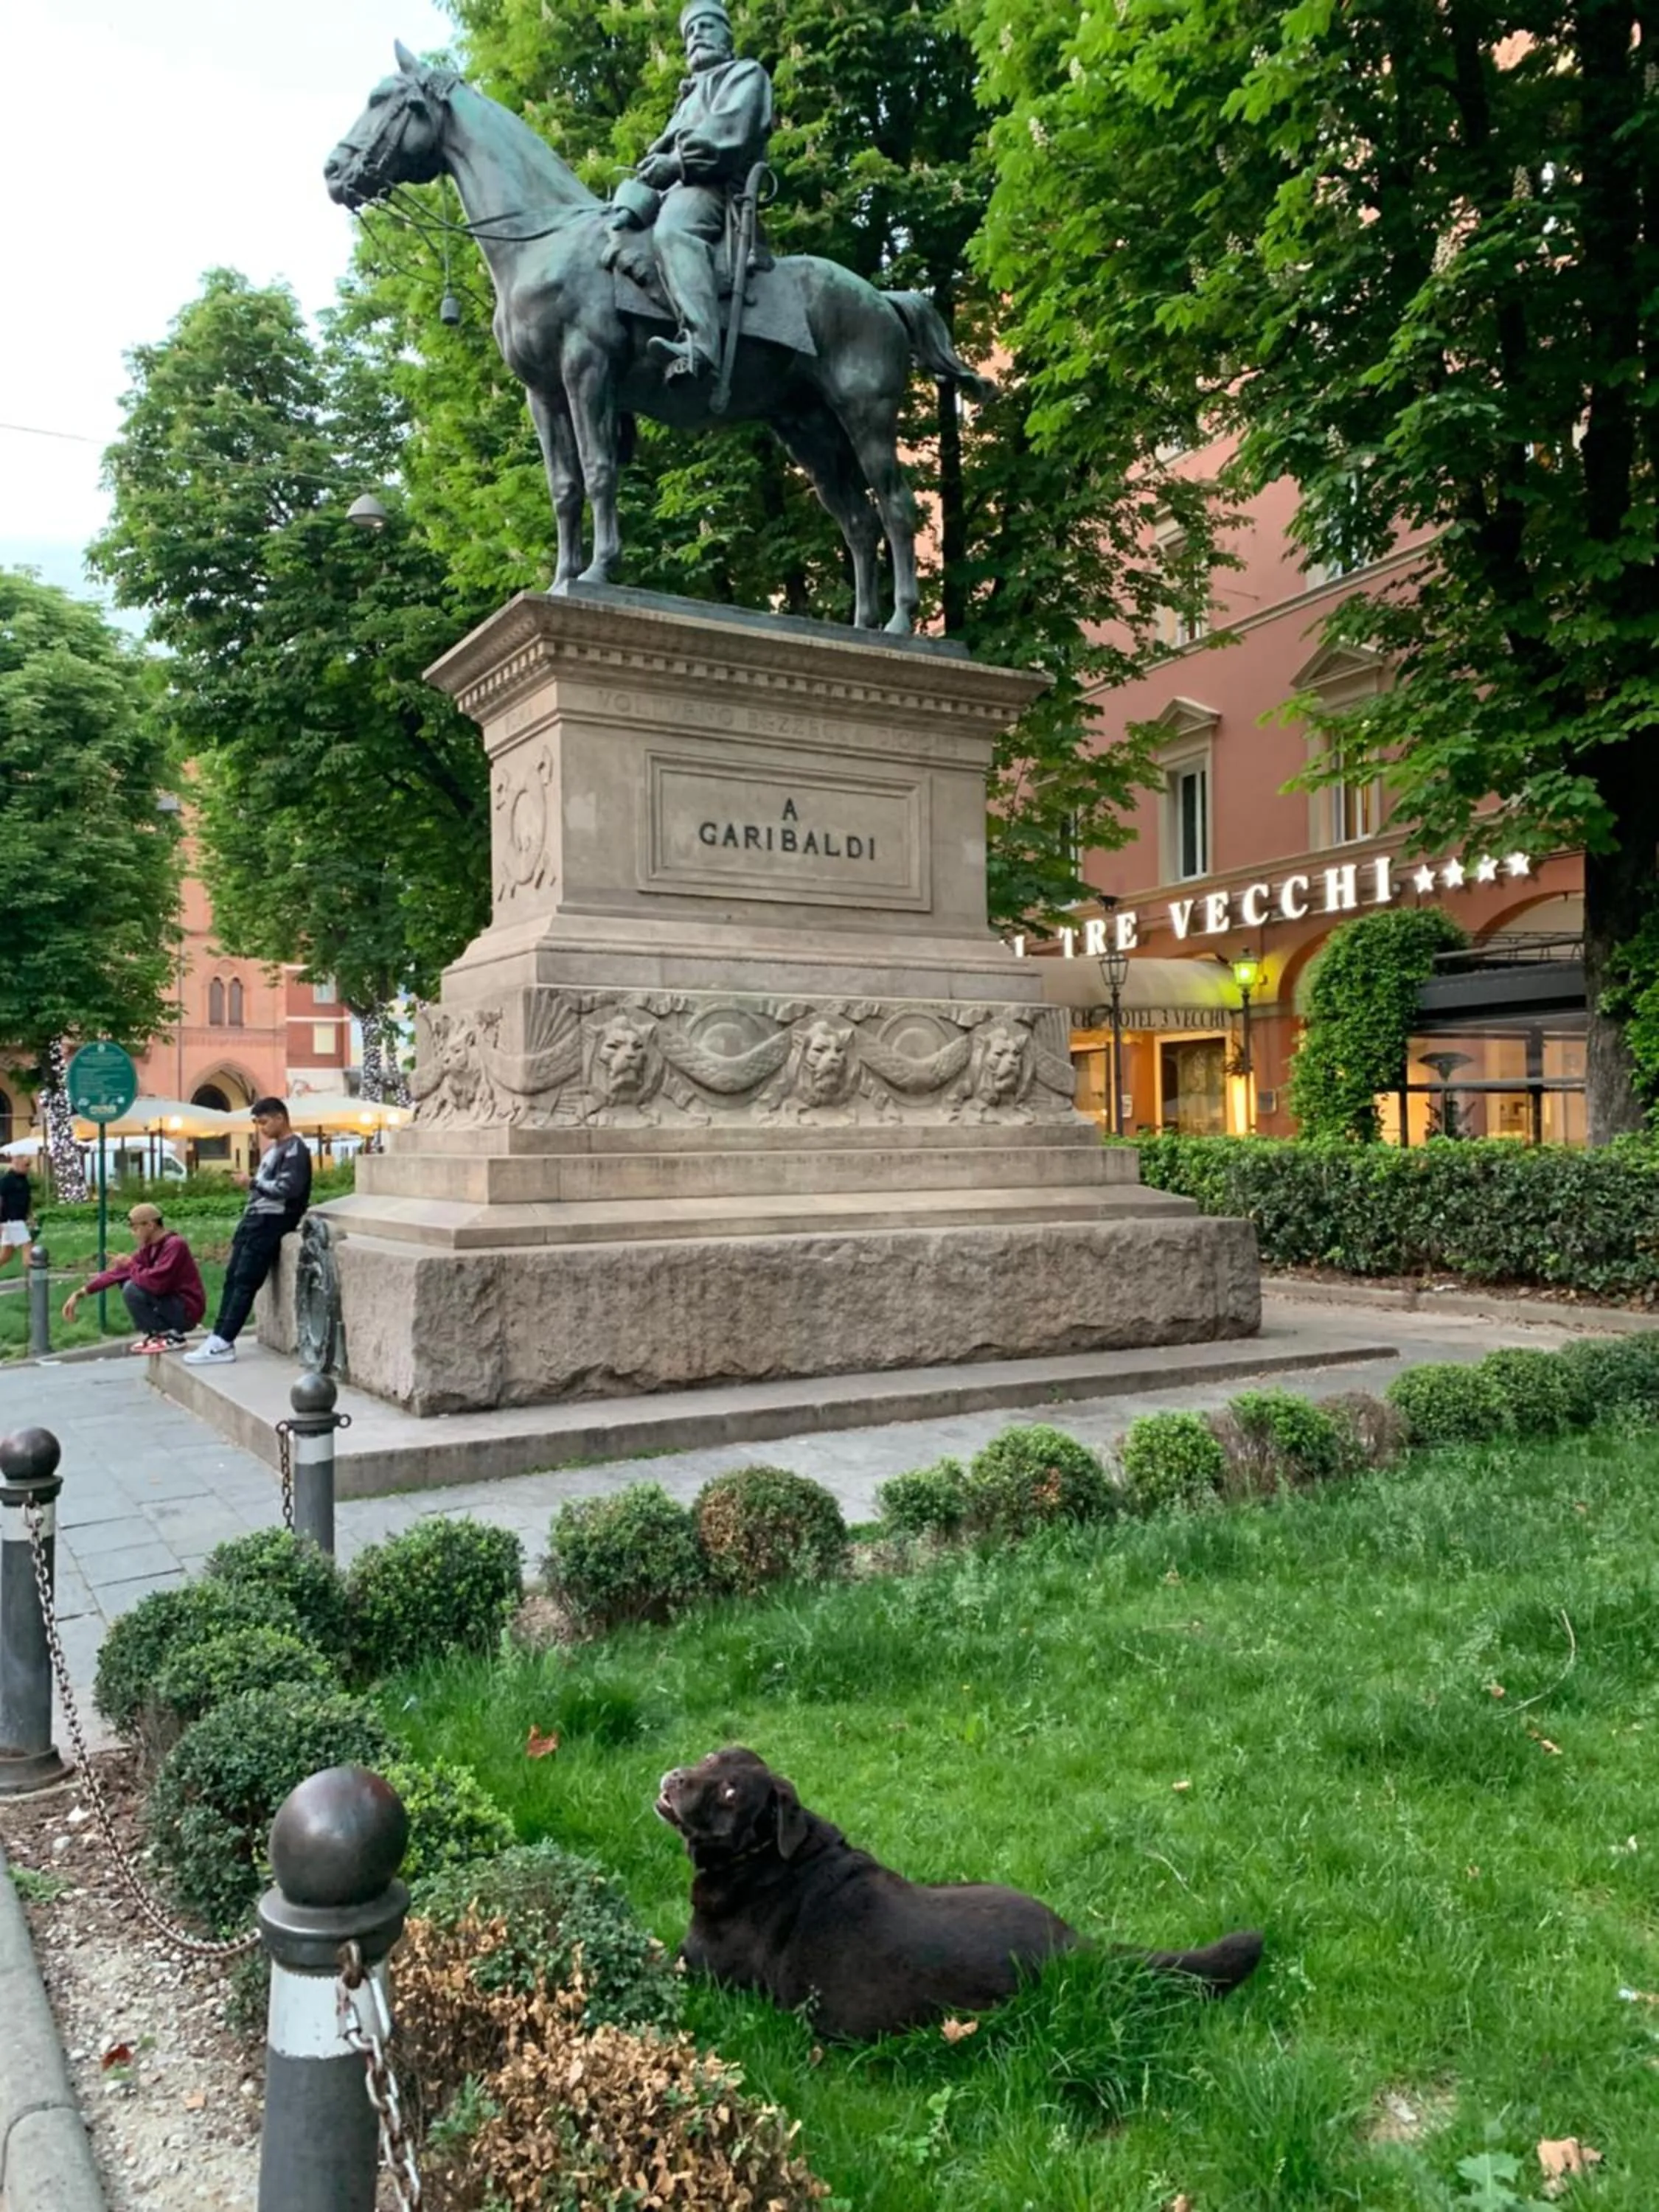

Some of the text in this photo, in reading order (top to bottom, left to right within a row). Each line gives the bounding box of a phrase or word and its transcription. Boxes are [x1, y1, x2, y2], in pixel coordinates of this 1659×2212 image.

[782, 797, 799, 822] A
[698, 821, 876, 861] GARIBALDI
[1058, 856, 1393, 959] TRE VECCHI
[1160, 1007, 1169, 1028] 3
[1174, 1007, 1225, 1028] VECCHI
